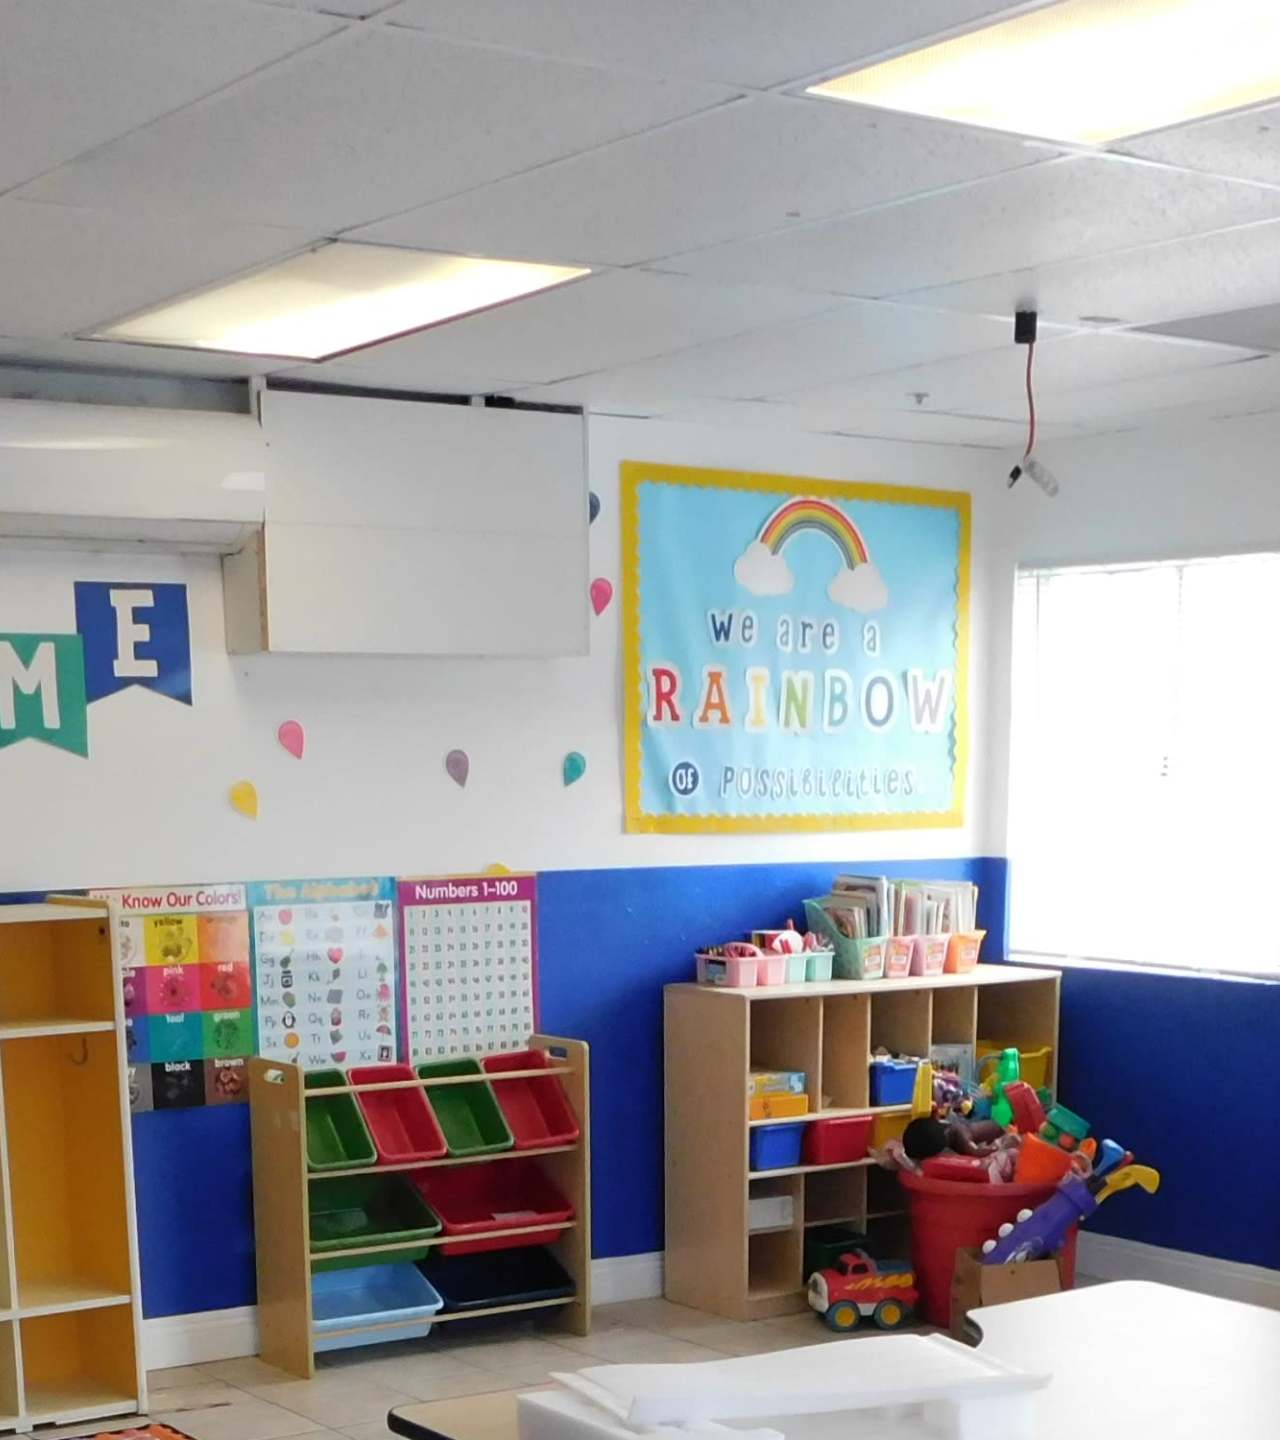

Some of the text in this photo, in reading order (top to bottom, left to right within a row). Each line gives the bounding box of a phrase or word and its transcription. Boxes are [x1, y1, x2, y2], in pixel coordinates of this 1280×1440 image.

[711, 612, 878, 653] We are a
[651, 667, 948, 729] RAINBOW
[122, 890, 241, 909] Know Our Colors!
[415, 884, 478, 900] Numbers
[165, 1062, 191, 1072] black
